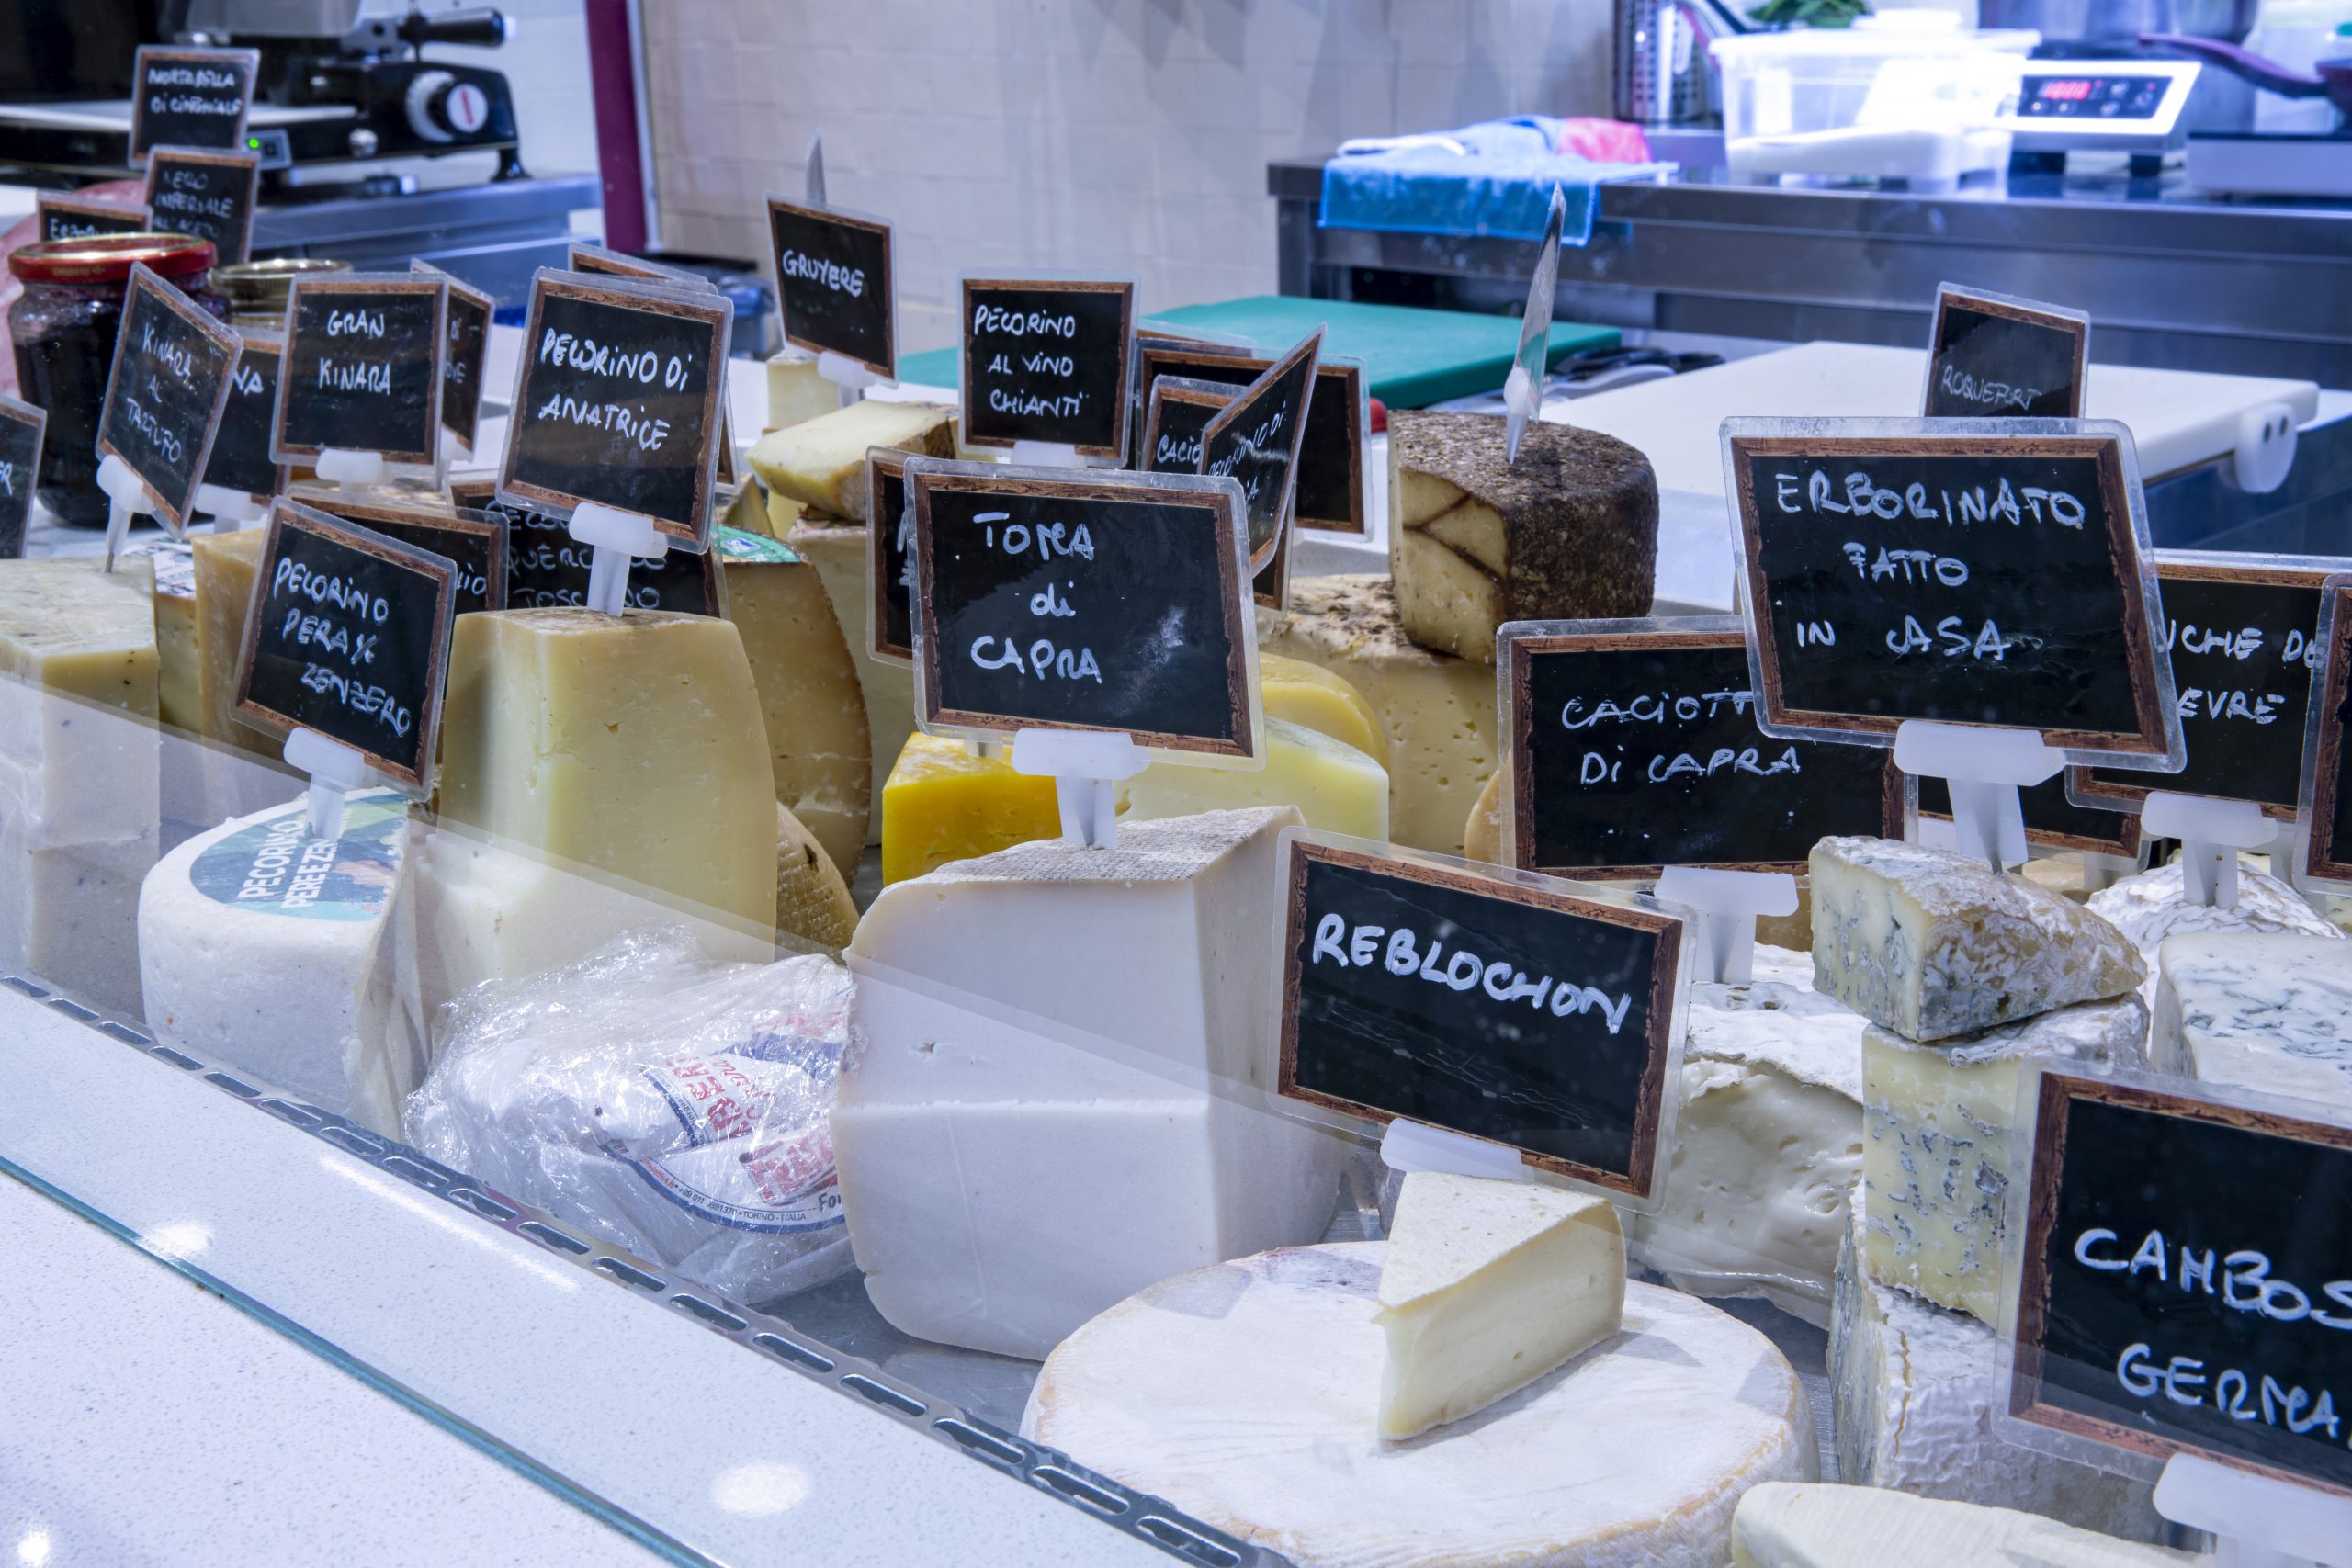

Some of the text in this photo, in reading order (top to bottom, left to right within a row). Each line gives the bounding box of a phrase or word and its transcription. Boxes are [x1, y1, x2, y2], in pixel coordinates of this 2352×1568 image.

[782, 249, 865, 298] GRUYERE
[326, 309, 385, 339] GRAN
[142, 322, 191, 378] KINARA
[988, 353, 1012, 374] AL
[148, 374, 162, 402] AL
[318, 357, 391, 396] KINARA
[127, 398, 181, 462] TARTUFO
[1775, 469, 2086, 530] ERBORINATO
[973, 512, 1095, 561] TOMA
[1842, 542, 1969, 587] FATTO
[1030, 581, 1076, 616] di
[283, 607, 348, 656] PERA
[1797, 615, 2012, 660] IN CASA
[970, 635, 1102, 684] CAPRA
[300, 661, 411, 738] ZENZERO
[1563, 690, 1756, 730] CACIOTT
[1648, 746, 1801, 783] CAPRA
[236, 820, 305, 899] PECORINO
[1312, 913, 1631, 1035] REBLOCHON
[742, 1210, 775, 1222] TORINO
[2116, 1343, 2352, 1439] GERMA
